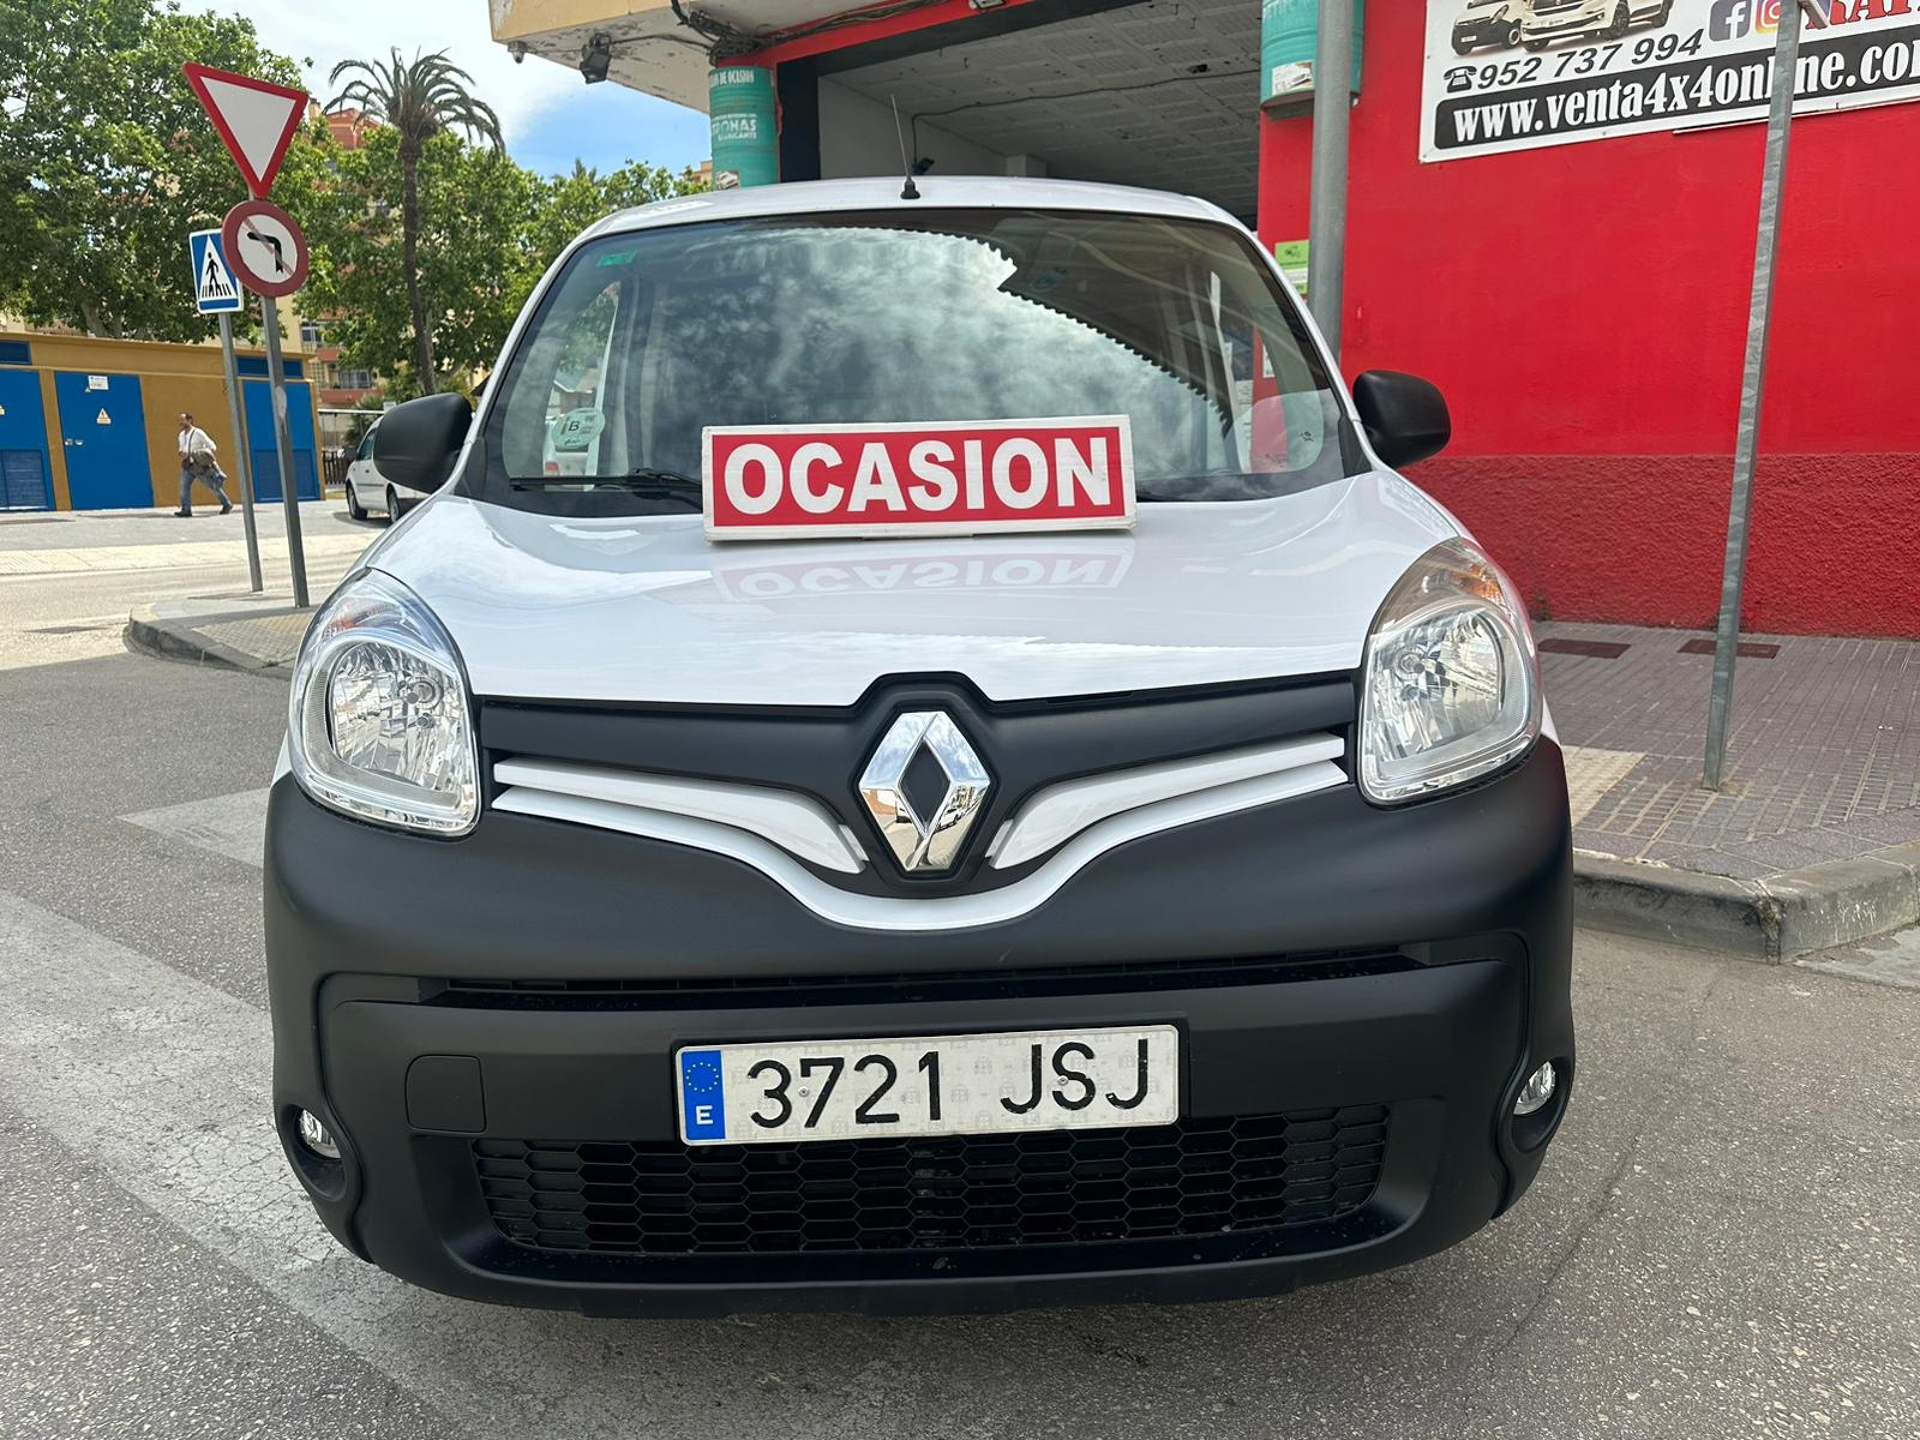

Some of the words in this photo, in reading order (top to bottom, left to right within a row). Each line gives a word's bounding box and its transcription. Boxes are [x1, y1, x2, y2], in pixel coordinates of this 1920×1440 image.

[1453, 39, 1920, 143] www.venta4x4onlne.co
[1477, 57, 1542, 89] 952
[1554, 44, 1623, 77] 737
[1631, 28, 1704, 66] 994
[568, 420, 580, 431] B
[724, 437, 1111, 515] OCASION
[696, 1105, 713, 1124] E
[747, 1051, 941, 1128] 3721
[1000, 1038, 1149, 1114] JSJ
